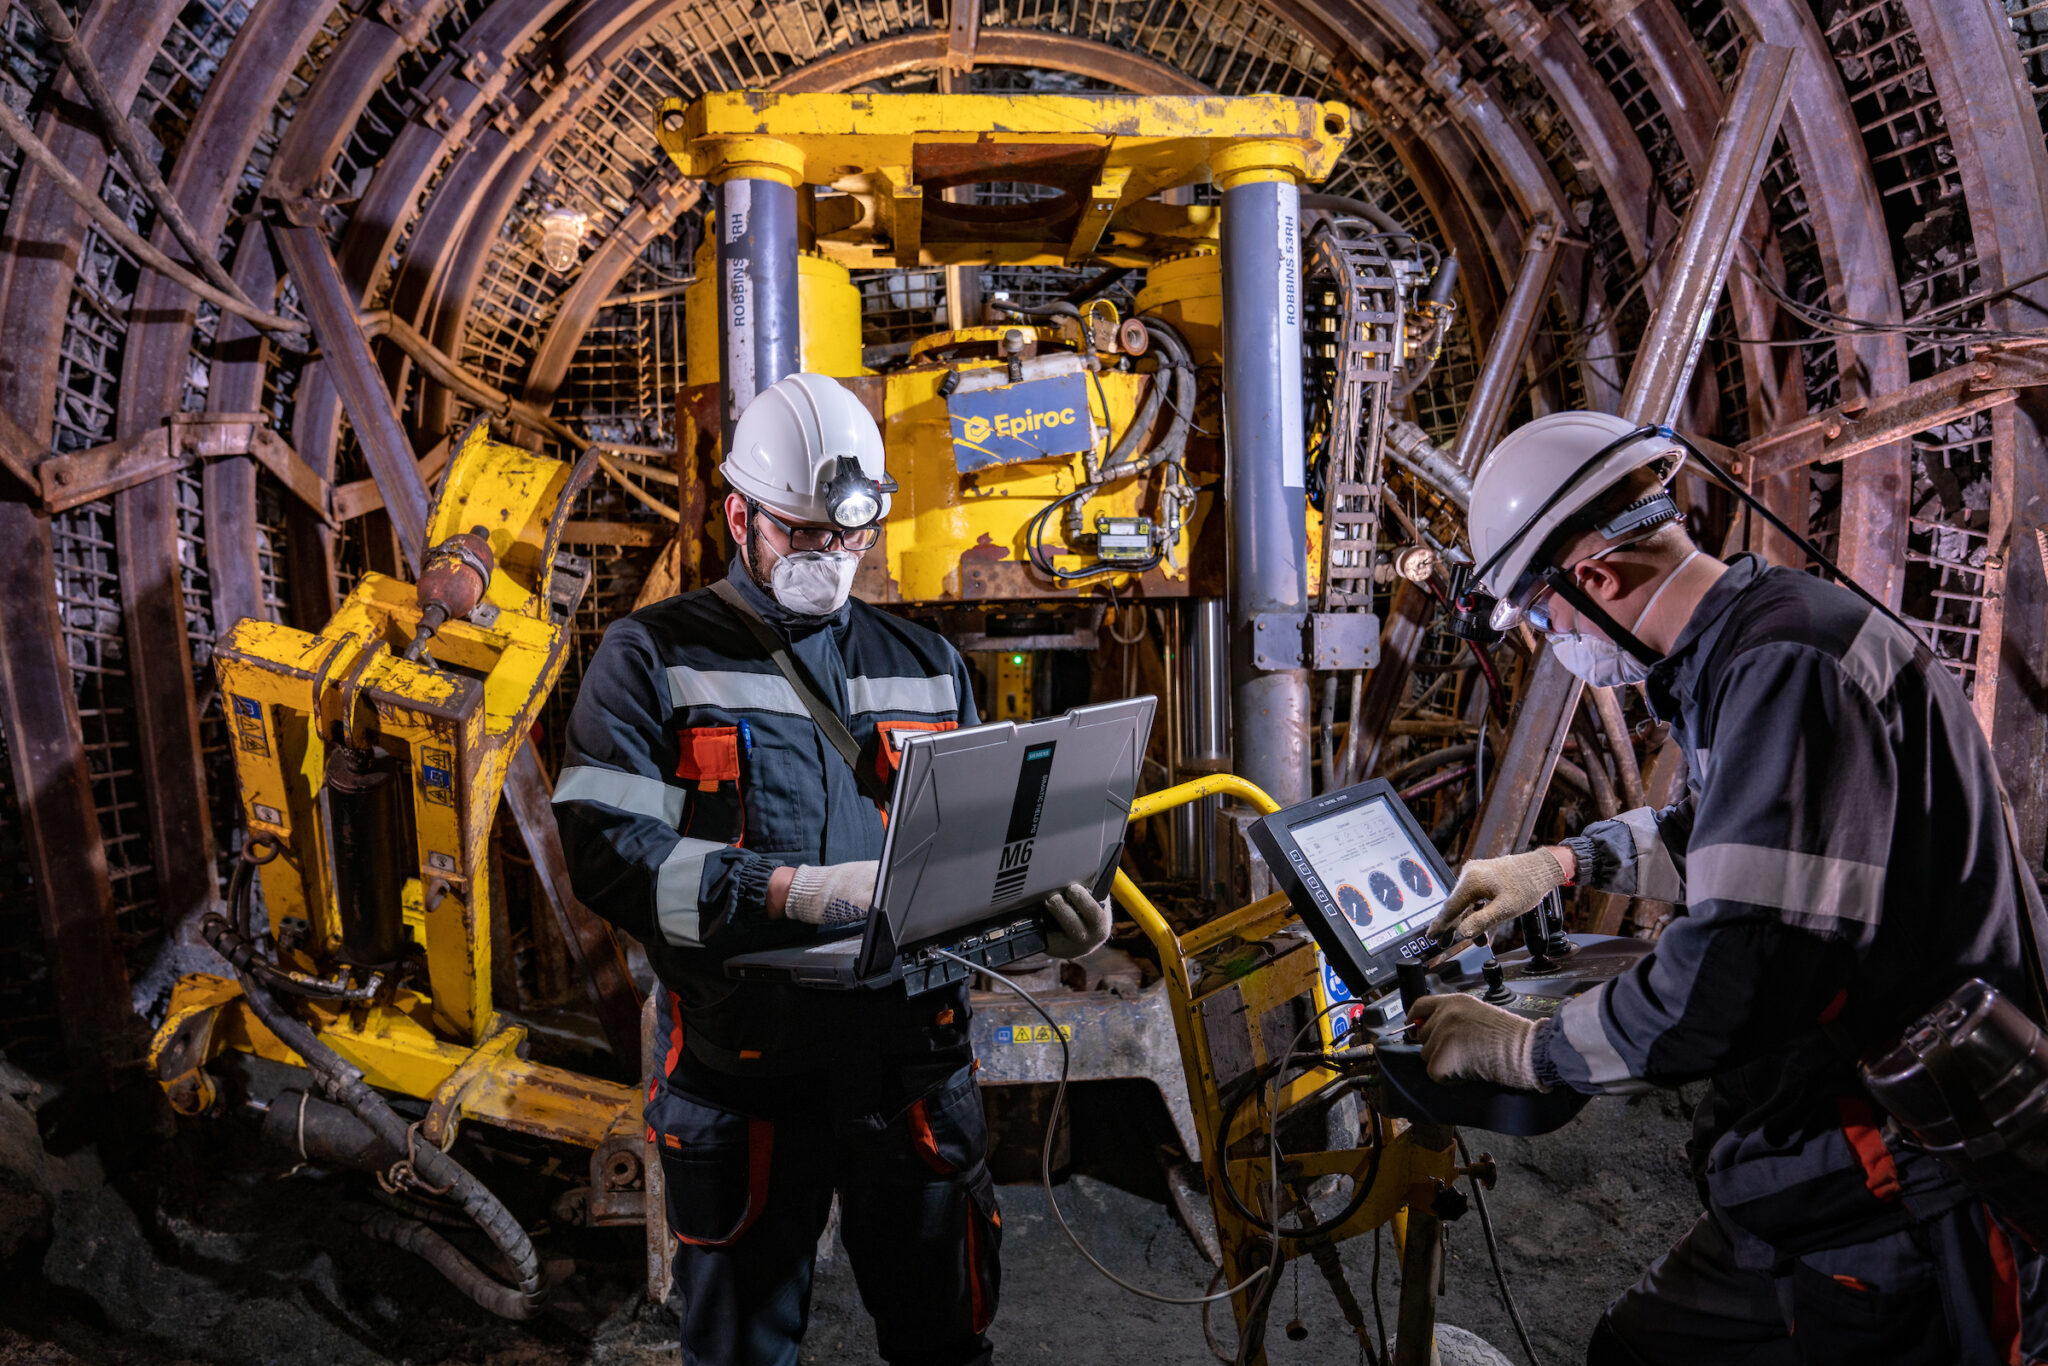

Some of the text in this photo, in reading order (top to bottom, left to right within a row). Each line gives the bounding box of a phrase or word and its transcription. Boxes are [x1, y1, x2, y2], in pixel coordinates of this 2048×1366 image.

[1285, 215, 1296, 326] ROBBINS 53RH
[733, 257, 745, 327] ROBBINS
[994, 407, 1076, 439] Epiroc
[1028, 750, 1049, 759] SIEMENS
[1037, 774, 1049, 803] SIMATIC
[1032, 803, 1042, 823] FIELD
[999, 839, 1034, 871] M6
